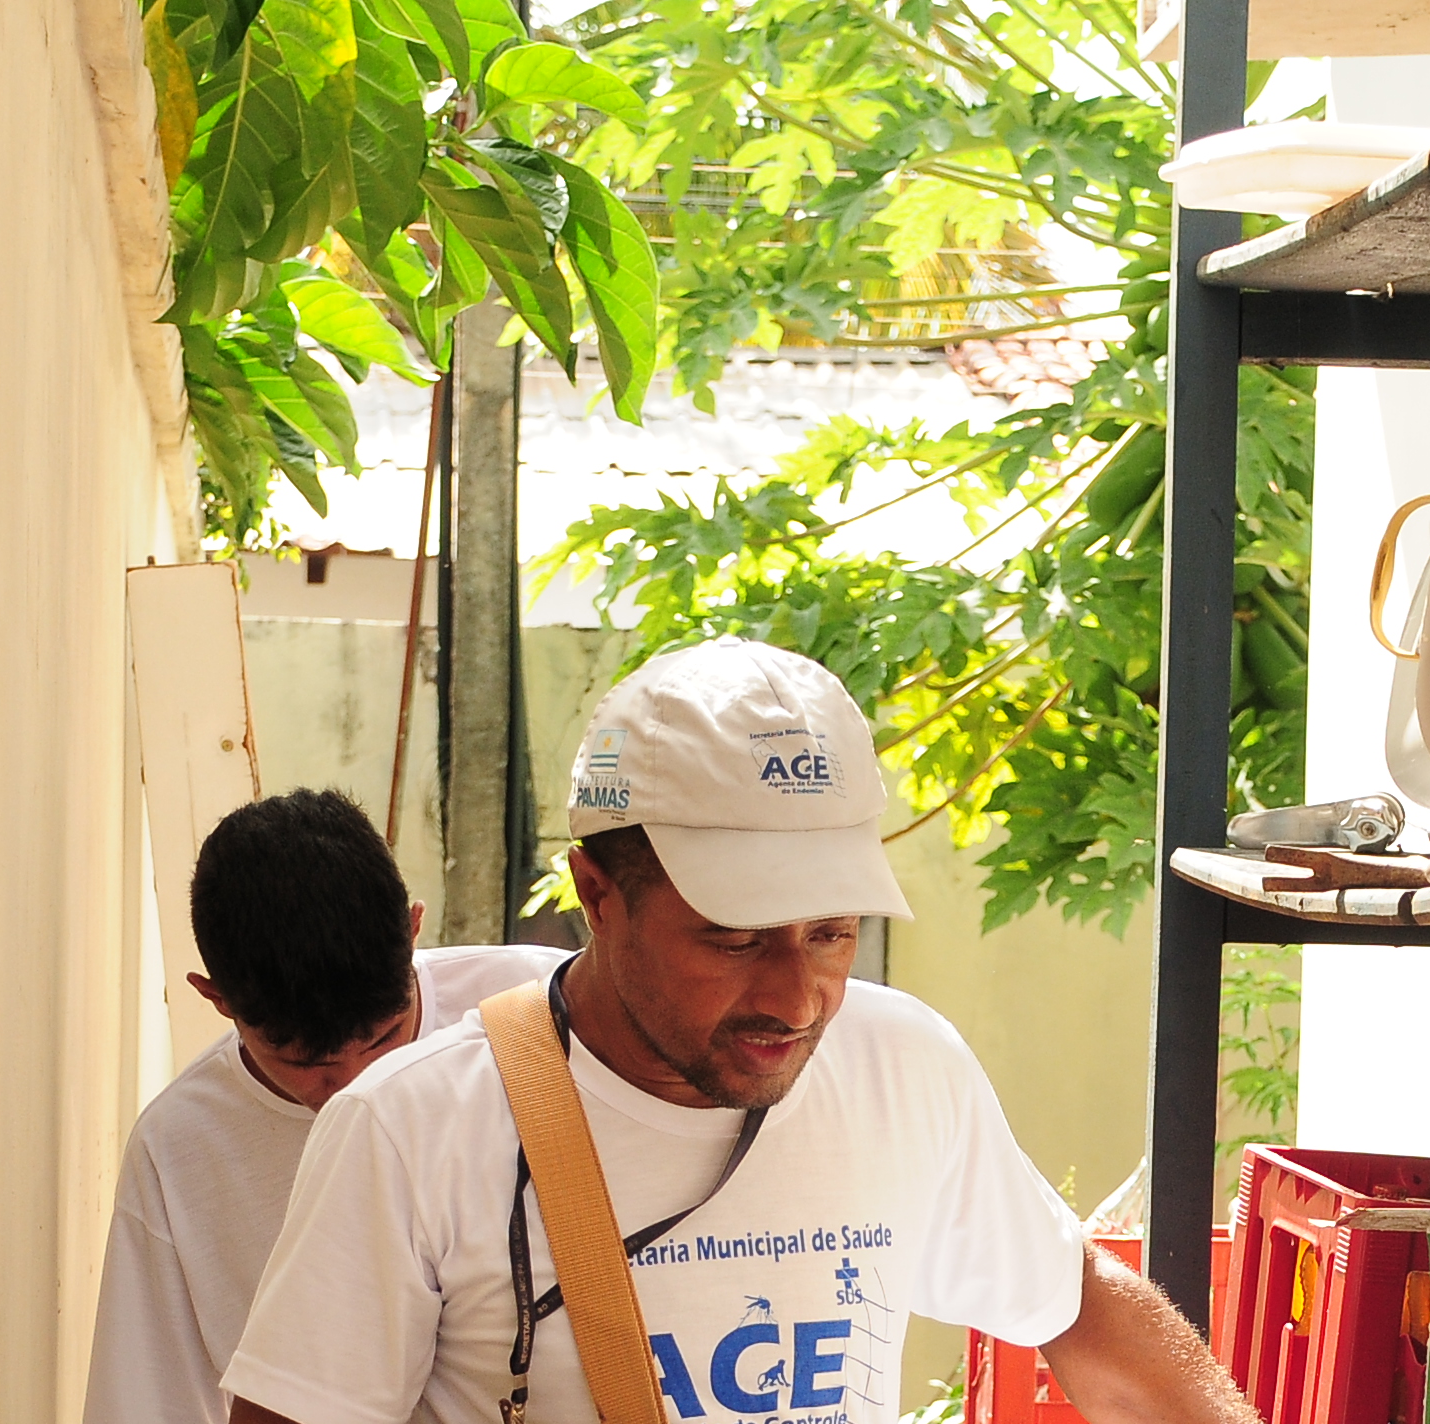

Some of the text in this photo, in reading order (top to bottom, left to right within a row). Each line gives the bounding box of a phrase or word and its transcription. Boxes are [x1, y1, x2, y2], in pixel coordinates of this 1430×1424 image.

[760, 754, 830, 780] ACE
[576, 786, 631, 809] PALMAS
[627, 1222, 893, 1268] taria Municipal de Saúde
[647, 1319, 853, 1419] ACE
